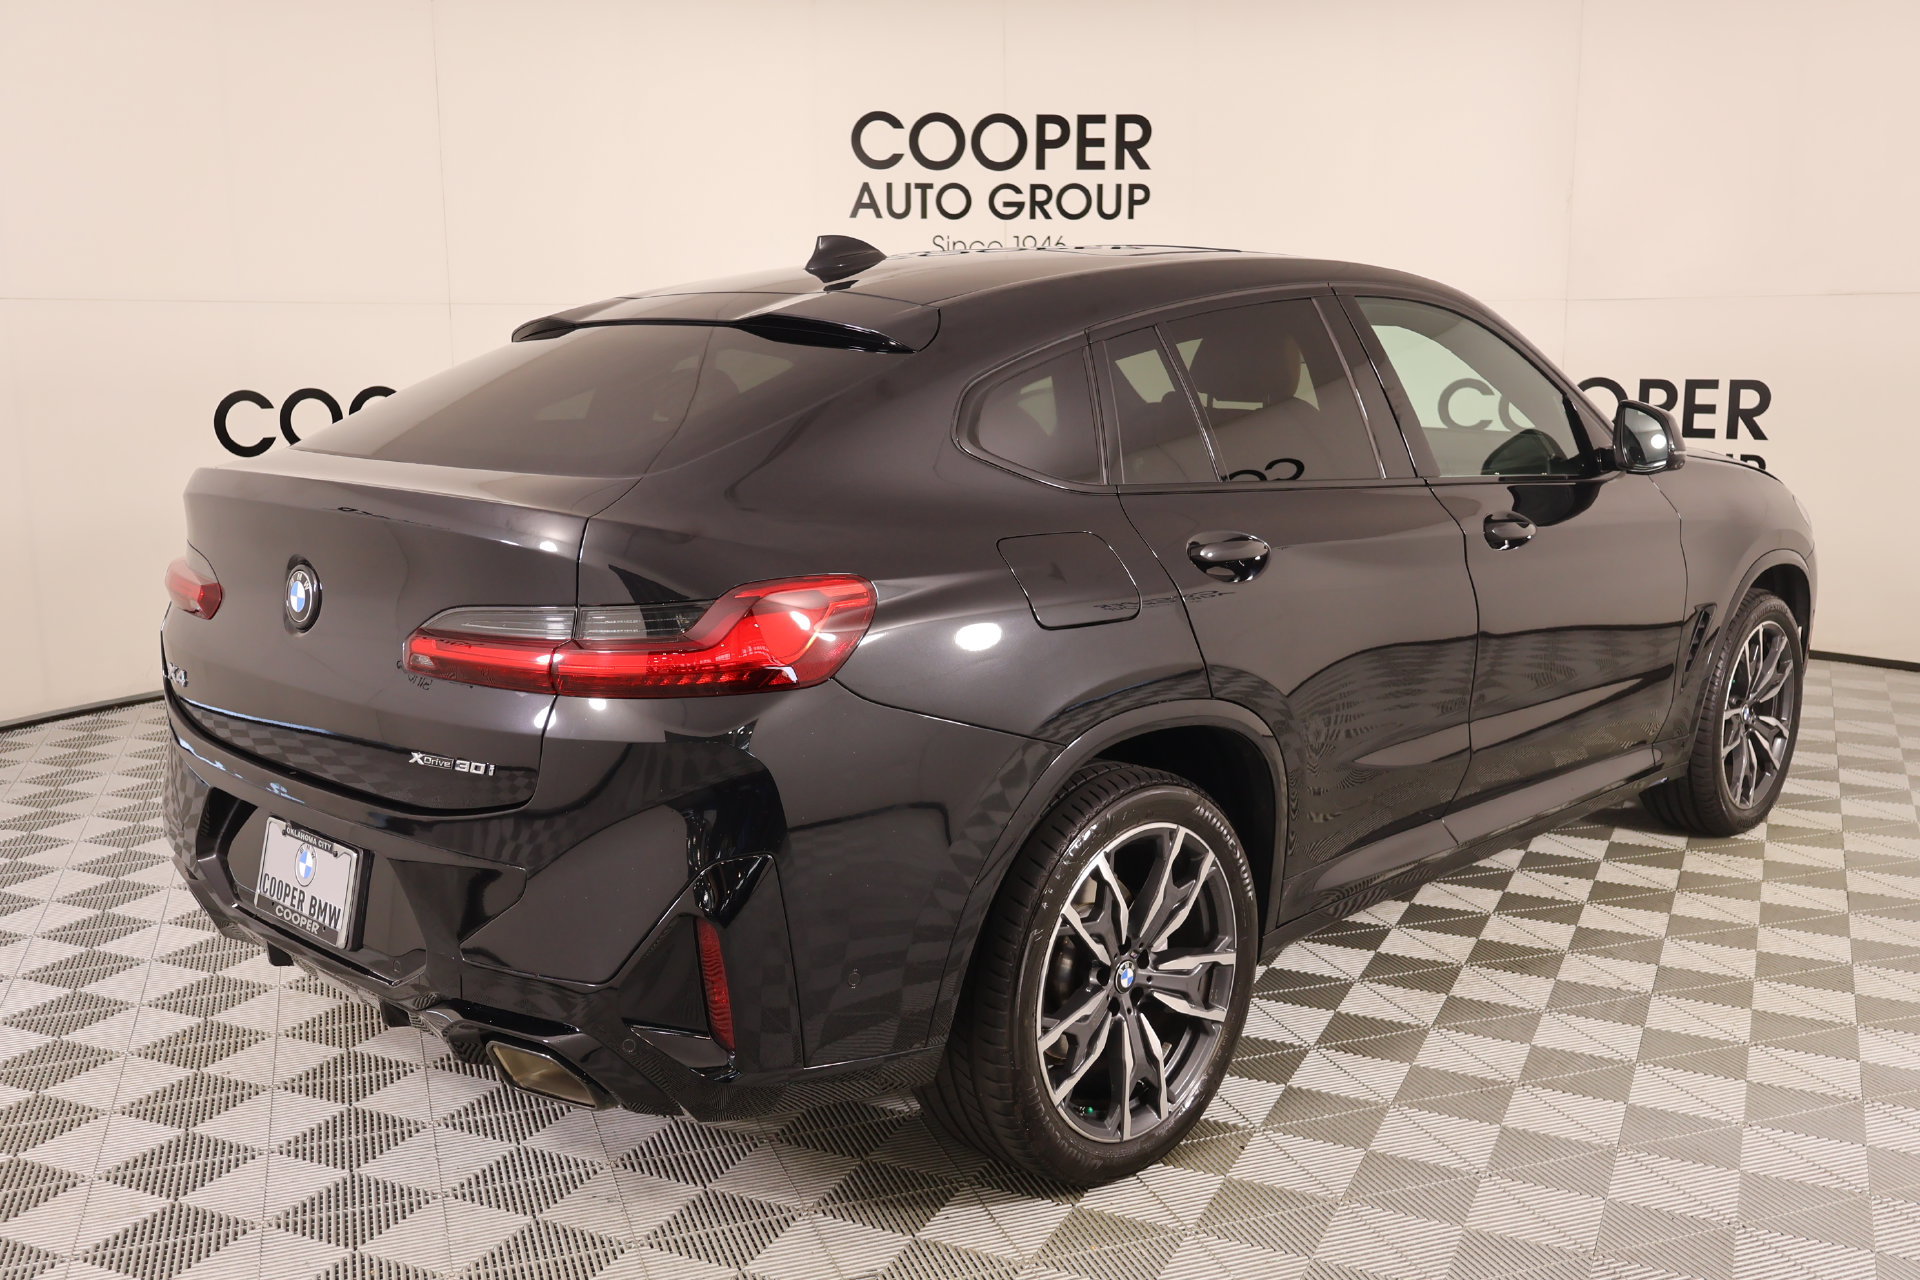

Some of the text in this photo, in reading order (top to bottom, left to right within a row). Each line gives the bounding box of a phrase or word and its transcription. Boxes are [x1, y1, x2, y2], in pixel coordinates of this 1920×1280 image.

[851, 110, 1153, 171] COOPER
[849, 181, 1151, 221] AUTO GROUP
[290, 572, 310, 591] BMW
[287, 827, 332, 851] OKLAHOMA CITY
[262, 873, 342, 929] COOPER BMW
[275, 905, 320, 934] COOPER
